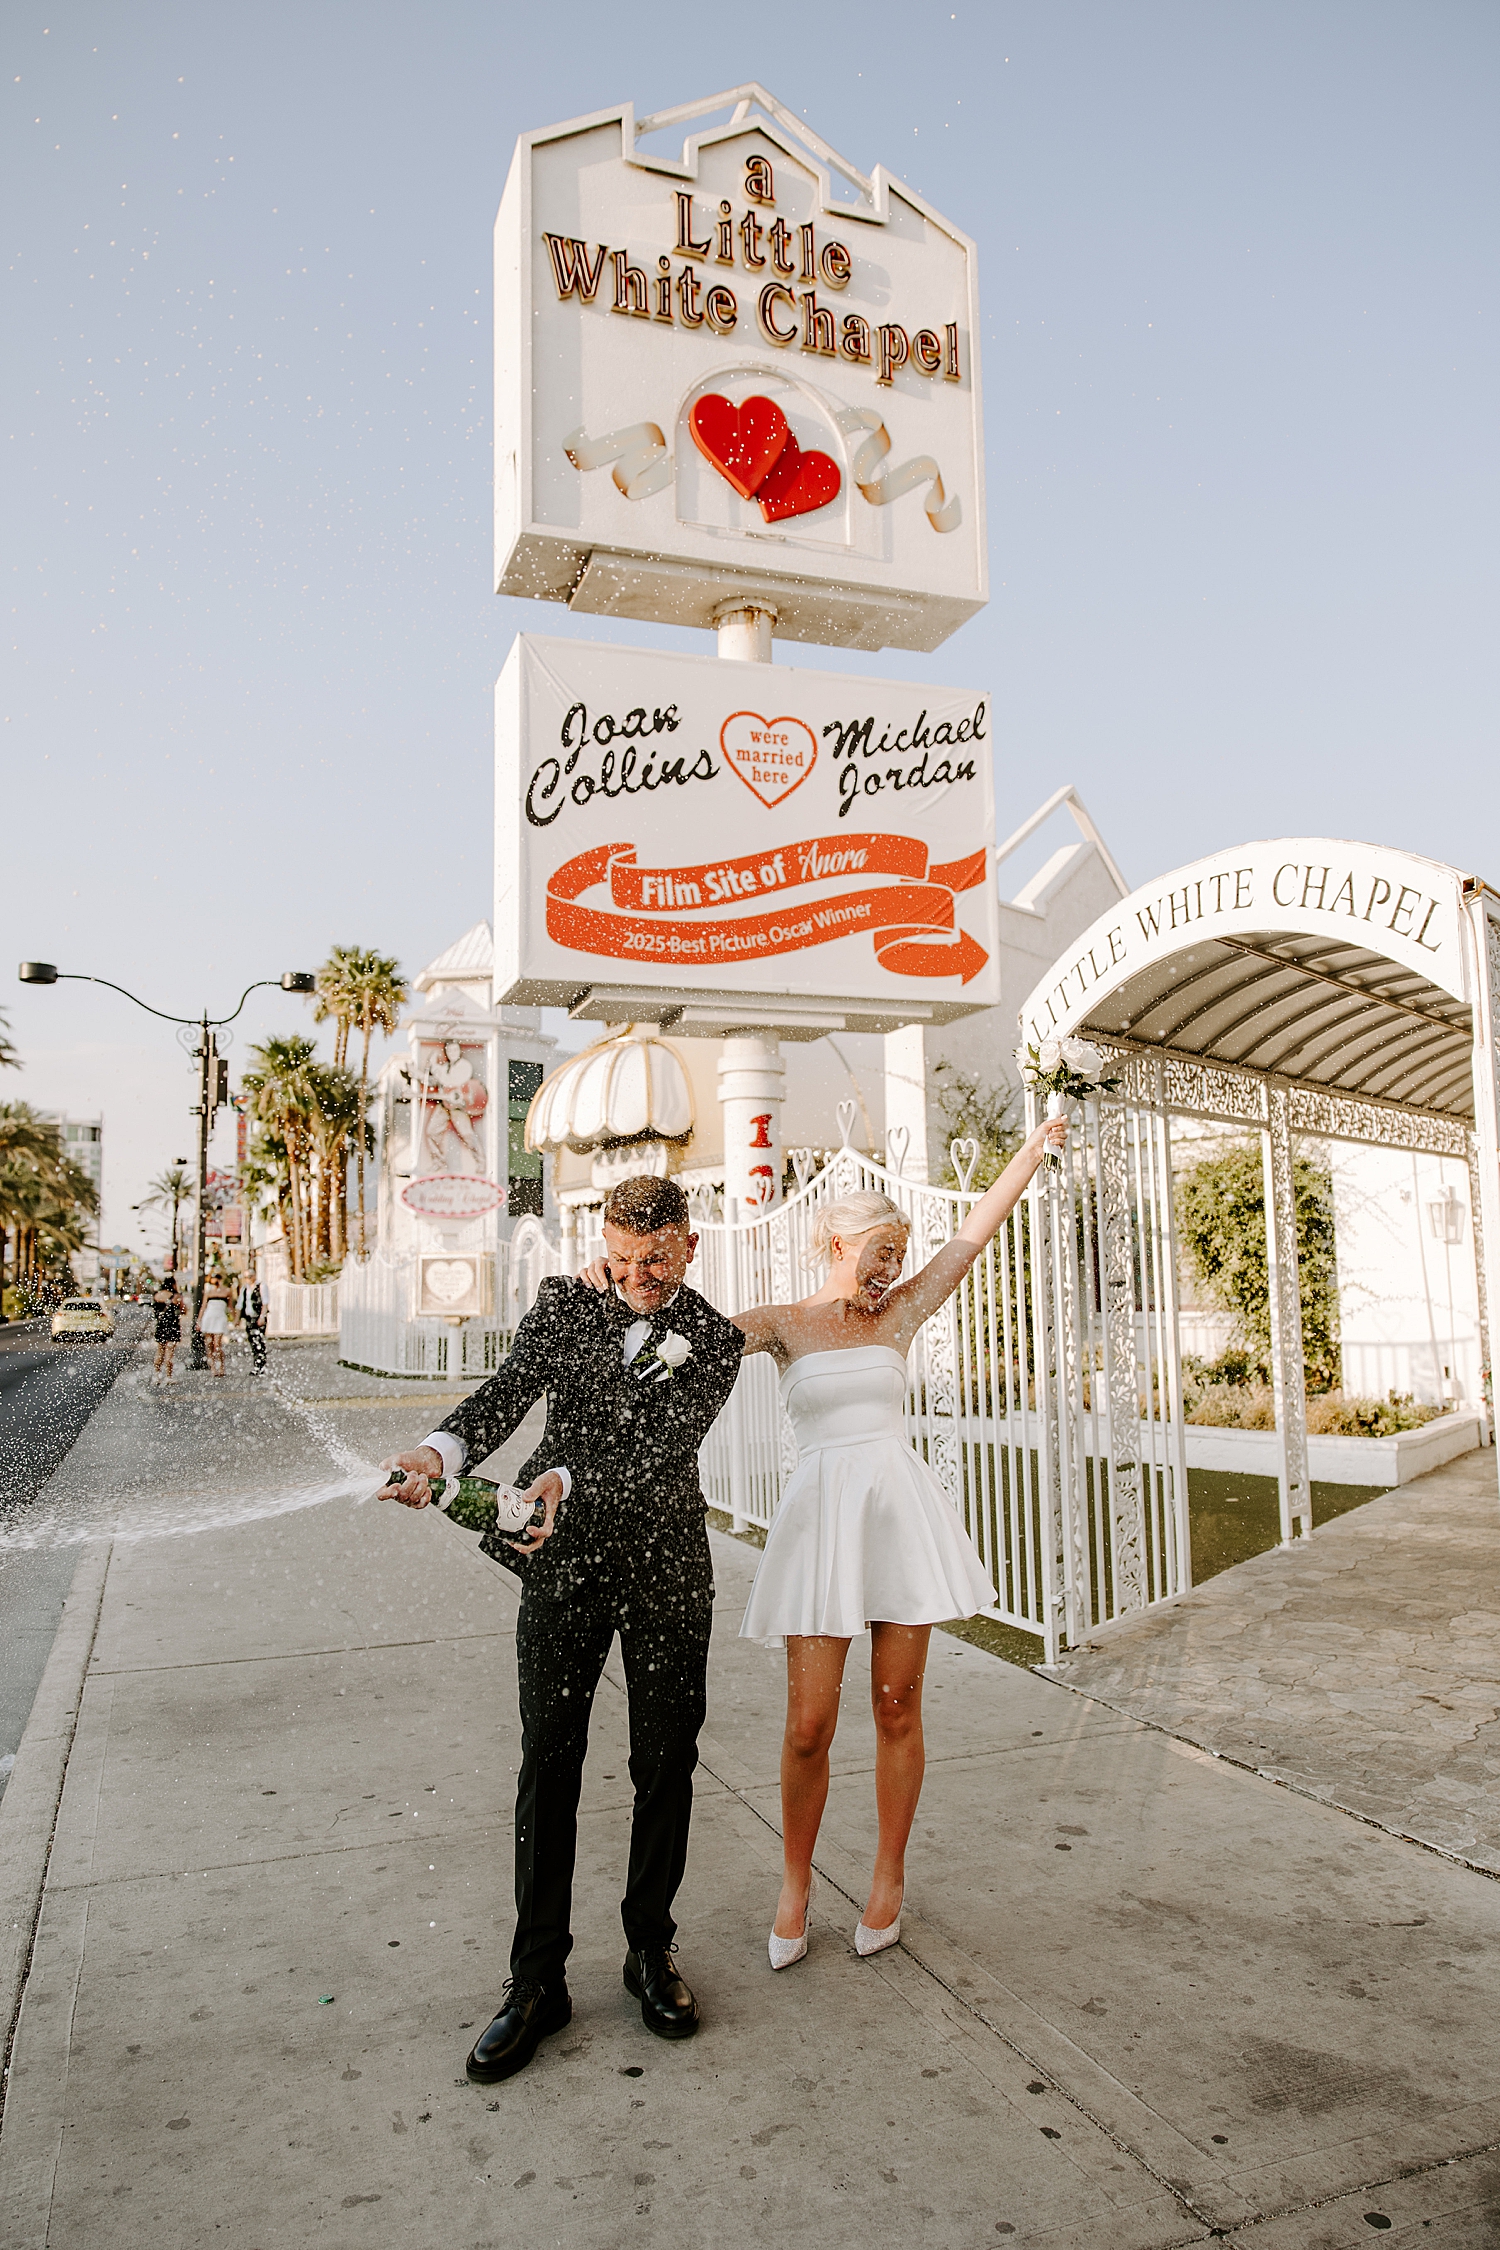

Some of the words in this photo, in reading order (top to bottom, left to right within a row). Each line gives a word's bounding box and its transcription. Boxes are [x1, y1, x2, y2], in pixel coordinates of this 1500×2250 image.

[744, 154, 775, 206] a
[672, 190, 853, 290] Little
[542, 231, 738, 334] White
[757, 281, 962, 386] Chapel
[561, 702, 682, 775] Joan
[736, 748, 804, 767] married
[749, 730, 789, 746] were
[822, 700, 987, 760] Michael
[525, 745, 721, 827] Collins
[751, 766, 789, 784] here
[838, 752, 977, 818] Jordan
[641, 874, 703, 907] Film
[702, 871, 758, 902] Site
[758, 853, 788, 885] of
[622, 930, 665, 952] 2025
[670, 933, 707, 955] Best
[708, 931, 767, 952] Picture
[768, 917, 814, 944] Oscar
[811, 901, 873, 930] Winner
[1029, 925, 1128, 1043] LITTLE
[1134, 868, 1255, 943] WHITE
[1272, 862, 1444, 953] CHAPEL
